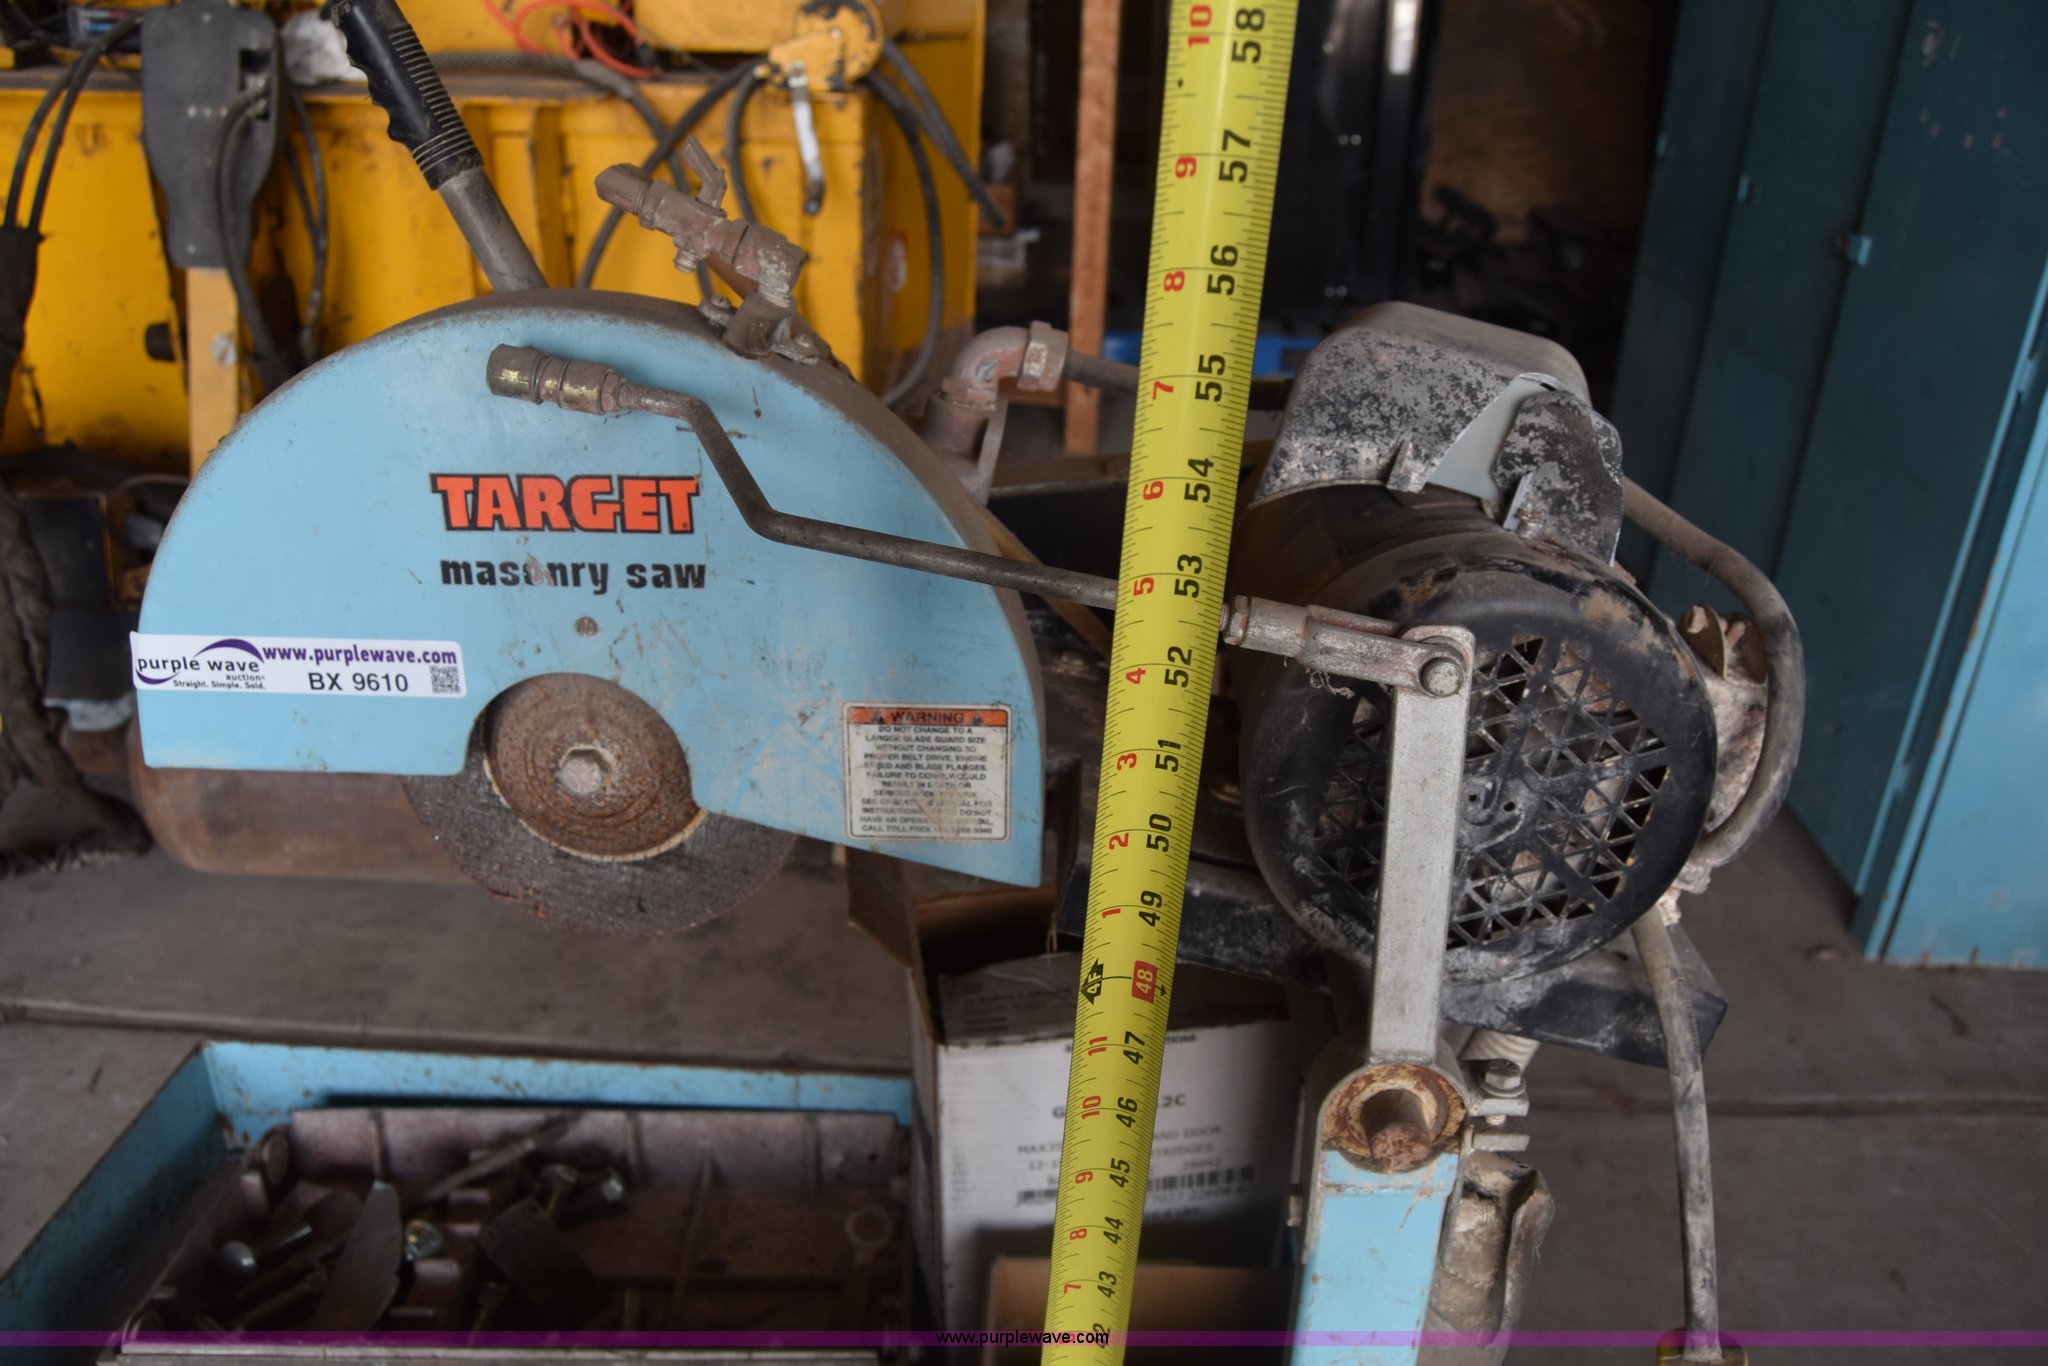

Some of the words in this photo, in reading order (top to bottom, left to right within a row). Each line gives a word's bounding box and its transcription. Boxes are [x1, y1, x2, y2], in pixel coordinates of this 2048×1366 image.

[1187, 4, 1213, 48] 10
[1231, 7, 1265, 63] 58
[1175, 156, 1197, 178] 9
[1218, 129, 1251, 183] 57
[1163, 271, 1185, 291] 8
[1206, 244, 1239, 295] 56
[1195, 354, 1226, 402] 55
[1152, 381, 1174, 400] 7
[1142, 480, 1164, 500] 6
[1184, 458, 1214, 502] 54
[429, 473, 700, 534] TARGET
[626, 563, 706, 589] saw
[1133, 576, 1154, 596] 5
[1174, 554, 1202, 598] 53
[138, 656, 200, 673] purple
[208, 660, 260, 672] wave
[262, 644, 457, 666] www.purplewave.com
[1164, 646, 1192, 688] 52
[173, 679, 209, 690] Straight.
[211, 682, 243, 690] Simple.
[308, 672, 343, 691] BX
[352, 673, 408, 692] 9610
[1125, 668, 1146, 684] 4
[891, 710, 964, 724] WARNING
[1116, 753, 1137, 770] 3
[1155, 739, 1181, 772] 51
[1108, 833, 1129, 849] 2
[1146, 813, 1172, 852] 50
[1101, 908, 1121, 918] 1
[1138, 890, 1162, 926] 49
[1086, 972, 1101, 995] 4F
[1135, 969, 1153, 994] 48
[1088, 1035, 1108, 1056] 11
[1123, 1031, 1146, 1064] 47
[1081, 1095, 1102, 1119] 10
[1116, 1096, 1138, 1128] 46
[1075, 1171, 1094, 1184] 9
[1109, 1158, 1131, 1187] 45
[1069, 1228, 1087, 1240] 8
[1103, 1216, 1124, 1244] 44
[1063, 1284, 1081, 1294] 7
[1097, 1271, 1117, 1298] 43
